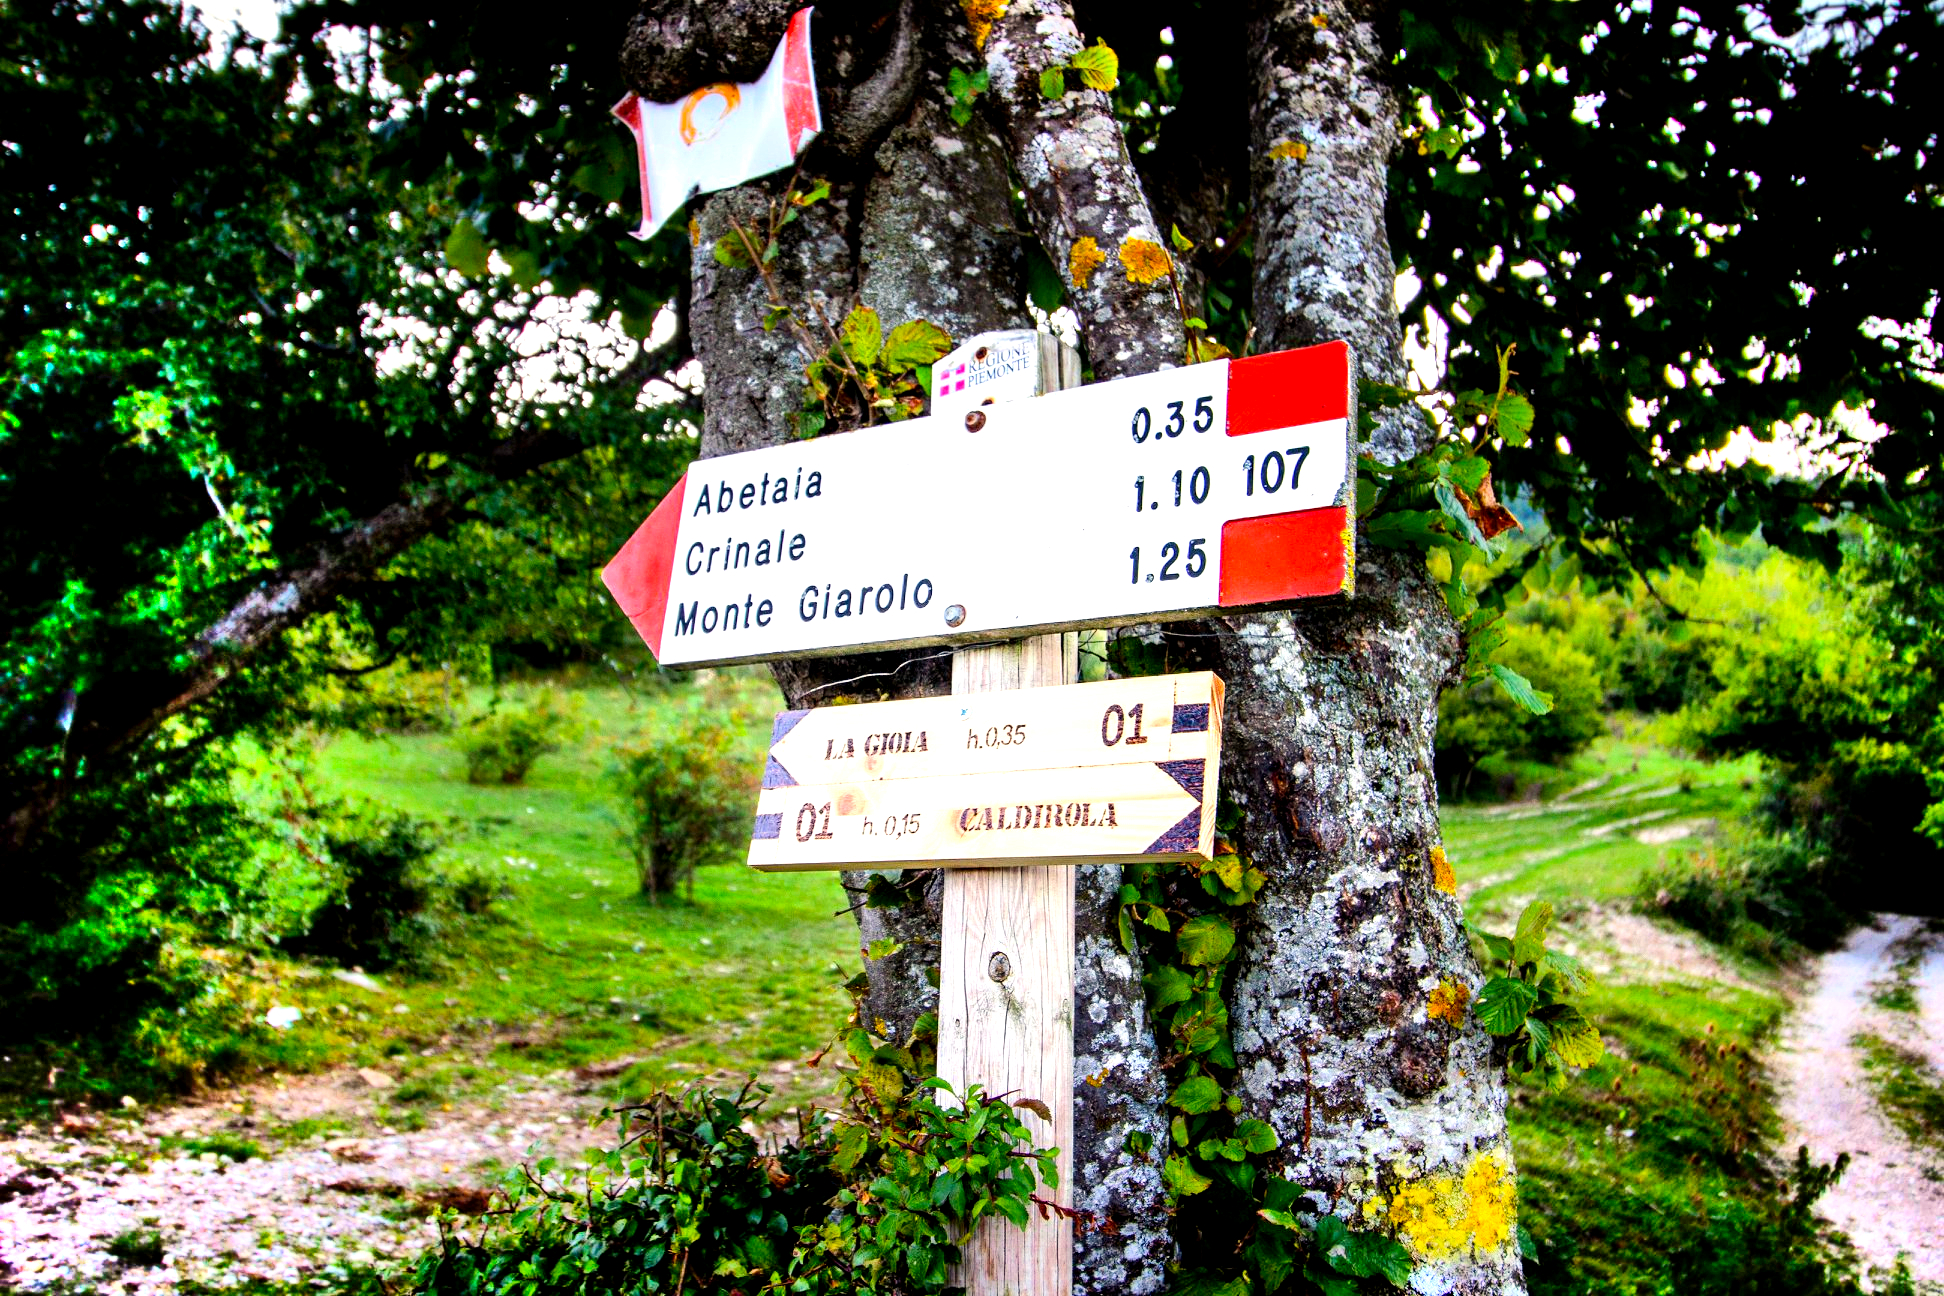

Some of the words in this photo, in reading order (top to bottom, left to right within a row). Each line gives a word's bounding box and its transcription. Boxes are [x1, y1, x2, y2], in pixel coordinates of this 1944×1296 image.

[967, 356, 1030, 388] PIEMONTE
[968, 341, 1030, 374] REGIONE
[1131, 395, 1213, 444] 0.35
[693, 467, 823, 518] Abetaia
[1133, 465, 1211, 513] 1.10
[1242, 446, 1310, 497] 107
[685, 529, 807, 576] Crinale
[1129, 538, 1207, 585] 1.25
[674, 593, 774, 637] Monte
[799, 573, 933, 622] Giarolo
[824, 738, 855, 760] LA
[864, 731, 929, 757] GIOIA
[1101, 703, 1149, 746] 01
[795, 801, 834, 843] 01
[959, 802, 1119, 832] CALDIROLA
